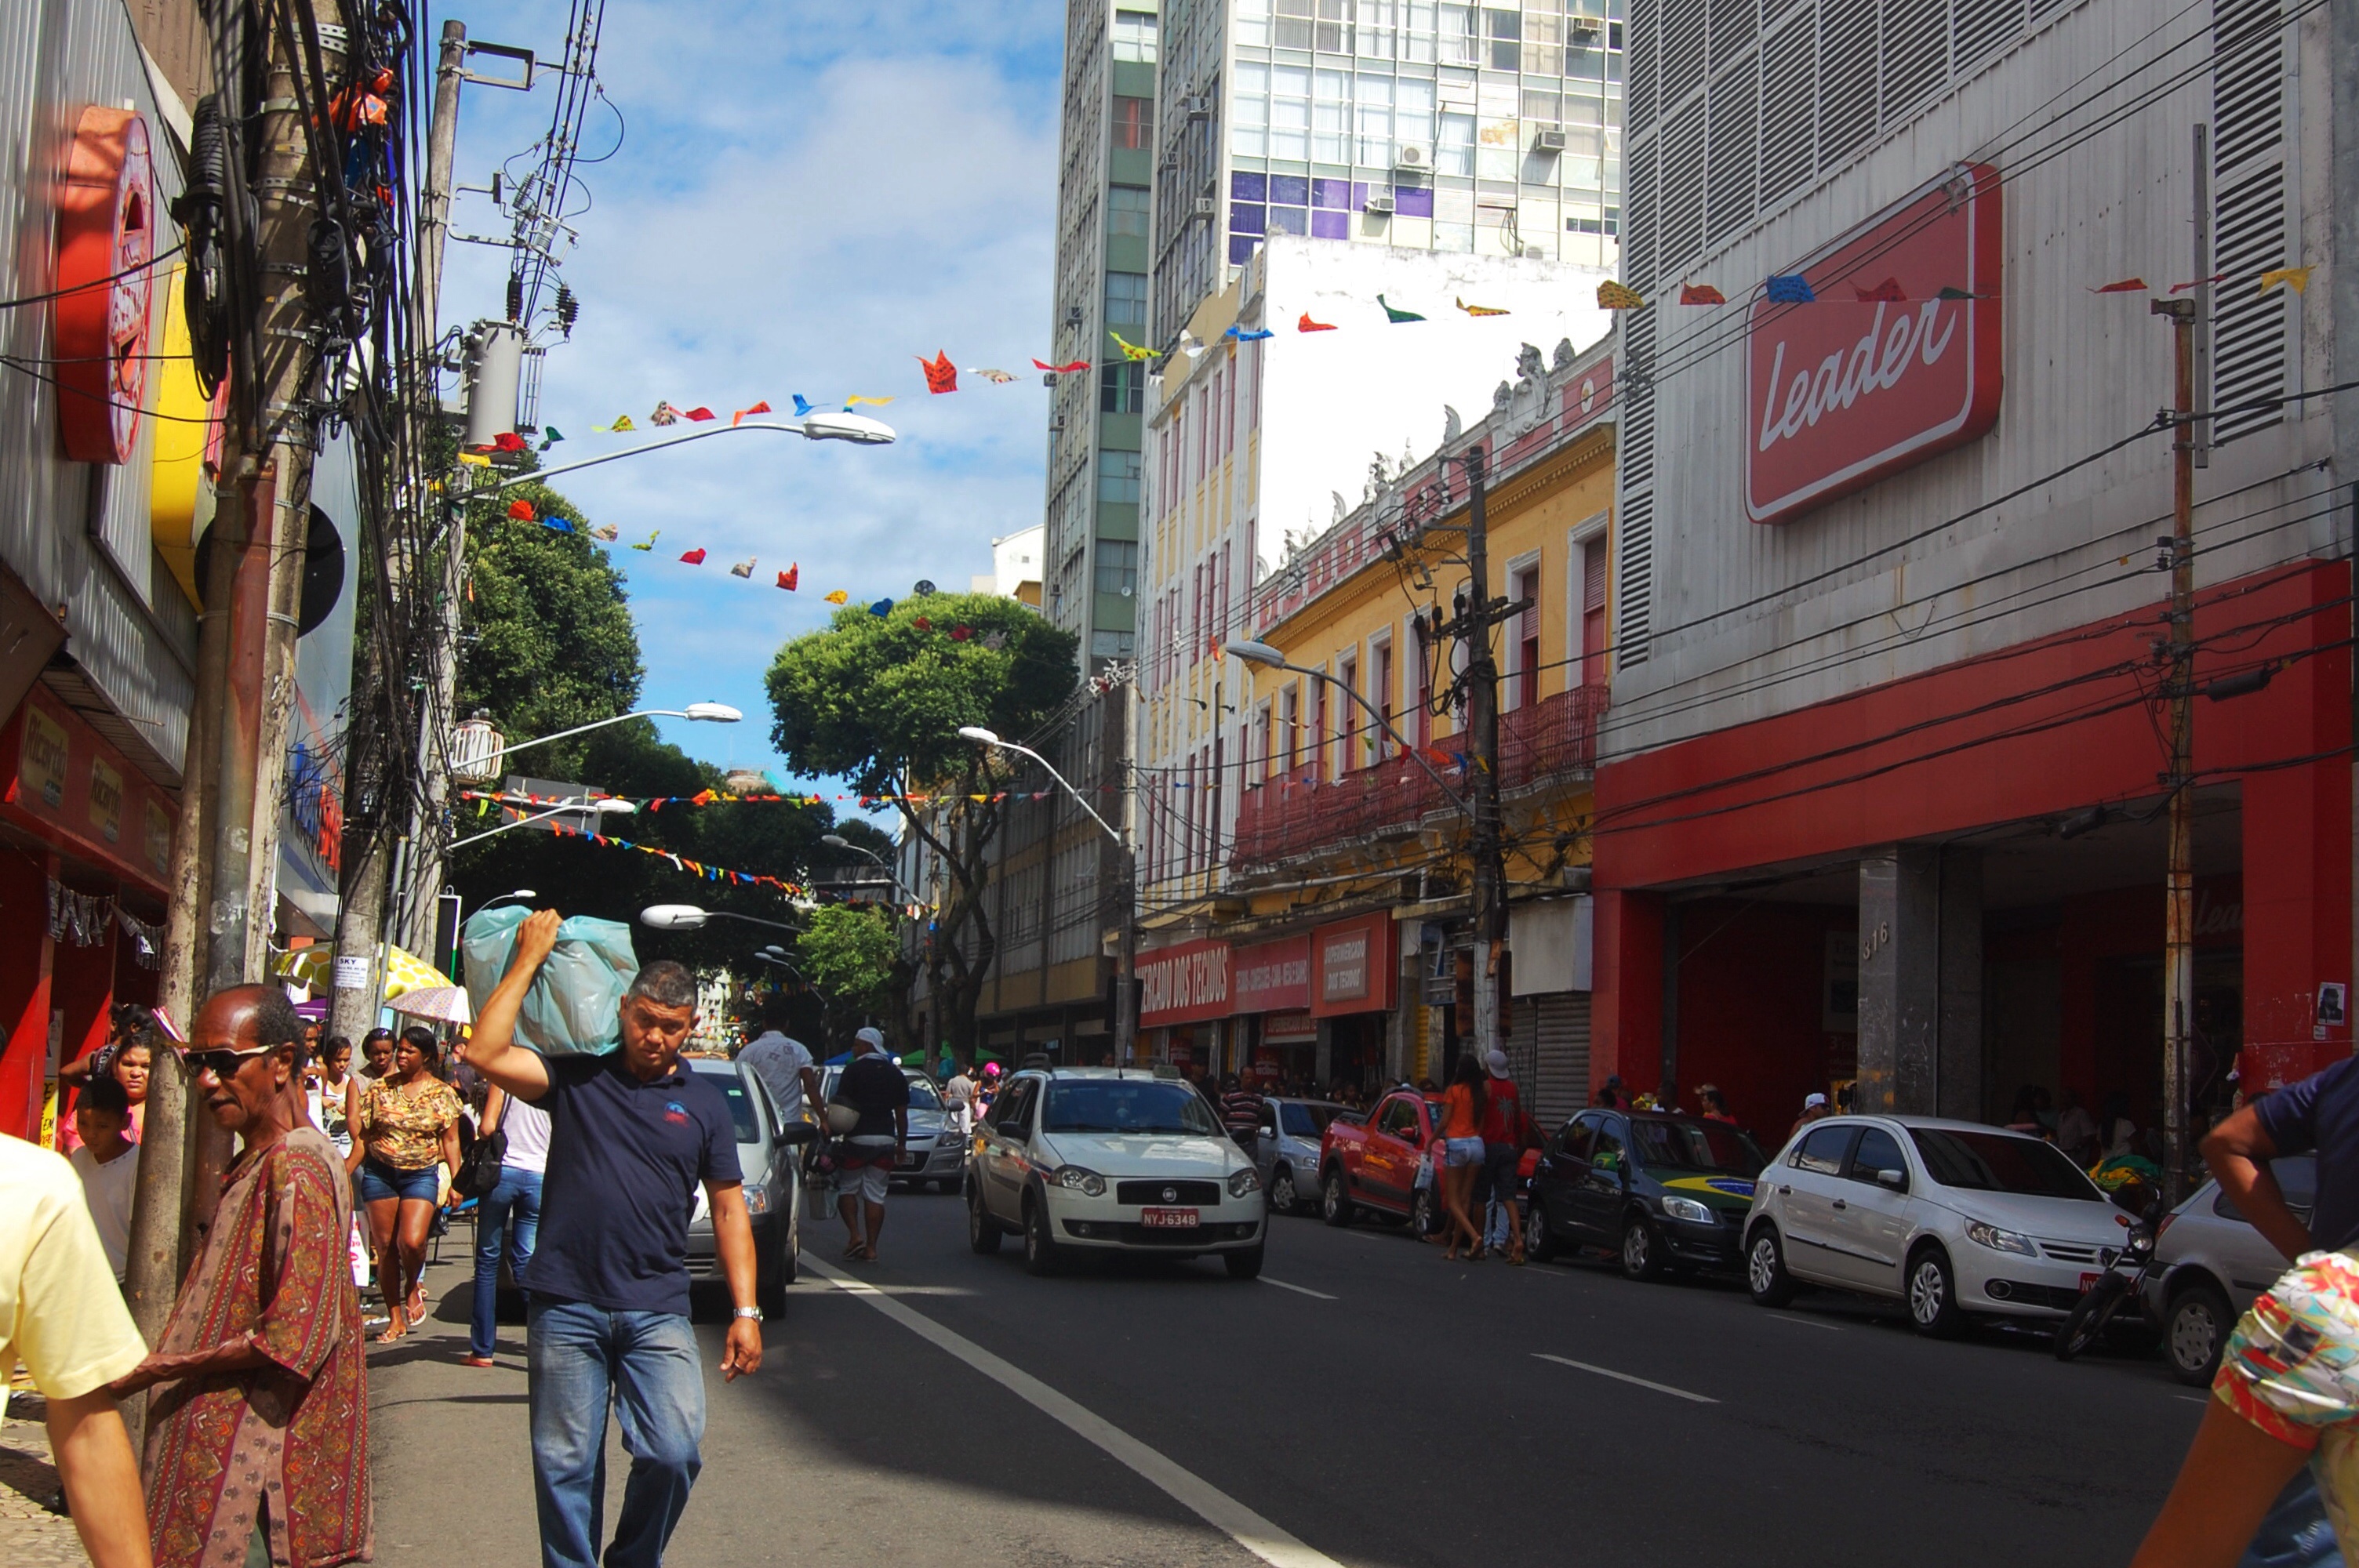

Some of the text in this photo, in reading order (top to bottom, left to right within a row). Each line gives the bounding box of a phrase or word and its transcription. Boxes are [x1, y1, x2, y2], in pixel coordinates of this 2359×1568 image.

[1759, 298, 1957, 452] Leader
[24, 713, 67, 781] Ricardo
[1863, 921, 1888, 960] 316
[1173, 955, 1190, 1008] DOS
[1192, 945, 1227, 1005] TECIDOS
[1328, 972, 1339, 991] DOS
